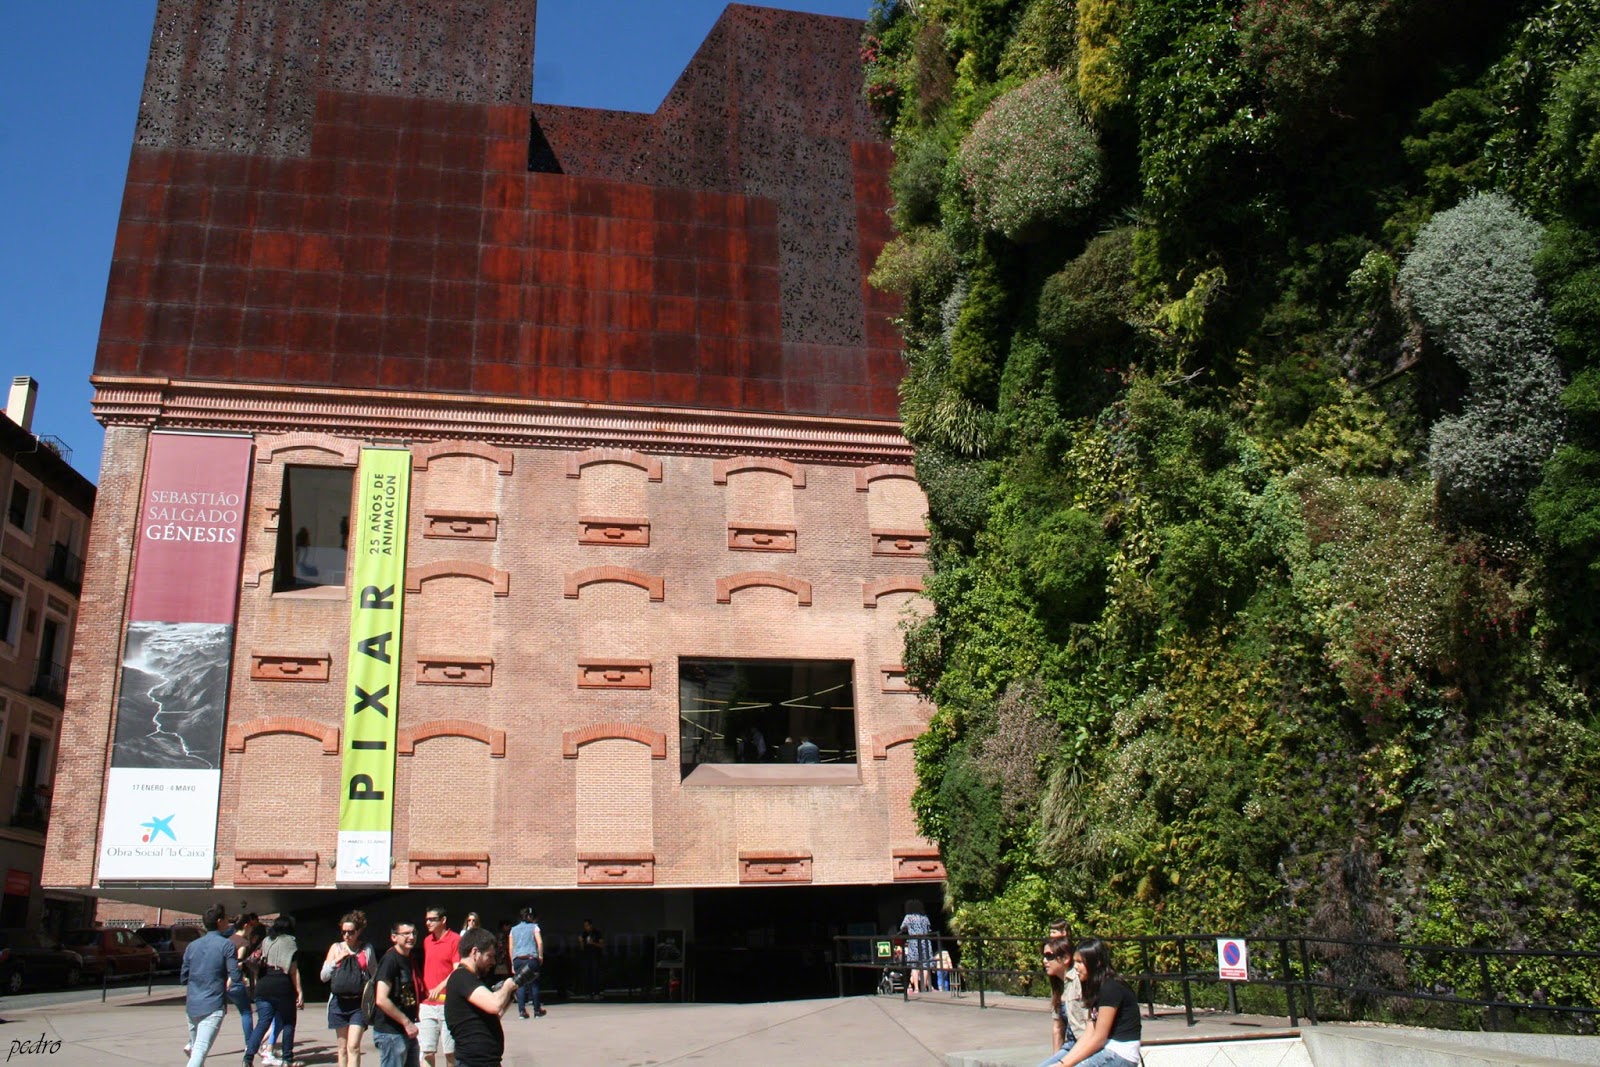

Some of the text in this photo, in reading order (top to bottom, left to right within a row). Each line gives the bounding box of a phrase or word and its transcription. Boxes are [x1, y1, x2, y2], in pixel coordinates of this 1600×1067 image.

[150, 490, 240, 506] SEBASTIÃO
[148, 506, 238, 524] SALGADO
[368, 473, 385, 555] 25 AÑOS DE
[382, 475, 397, 556] ANIMACIÓN
[146, 522, 236, 543] GÉNESIS
[349, 583, 395, 801] PIXAR
[141, 784, 165, 792] ENERO
[107, 847, 133, 857] Obra
[135, 847, 163, 857] Social
